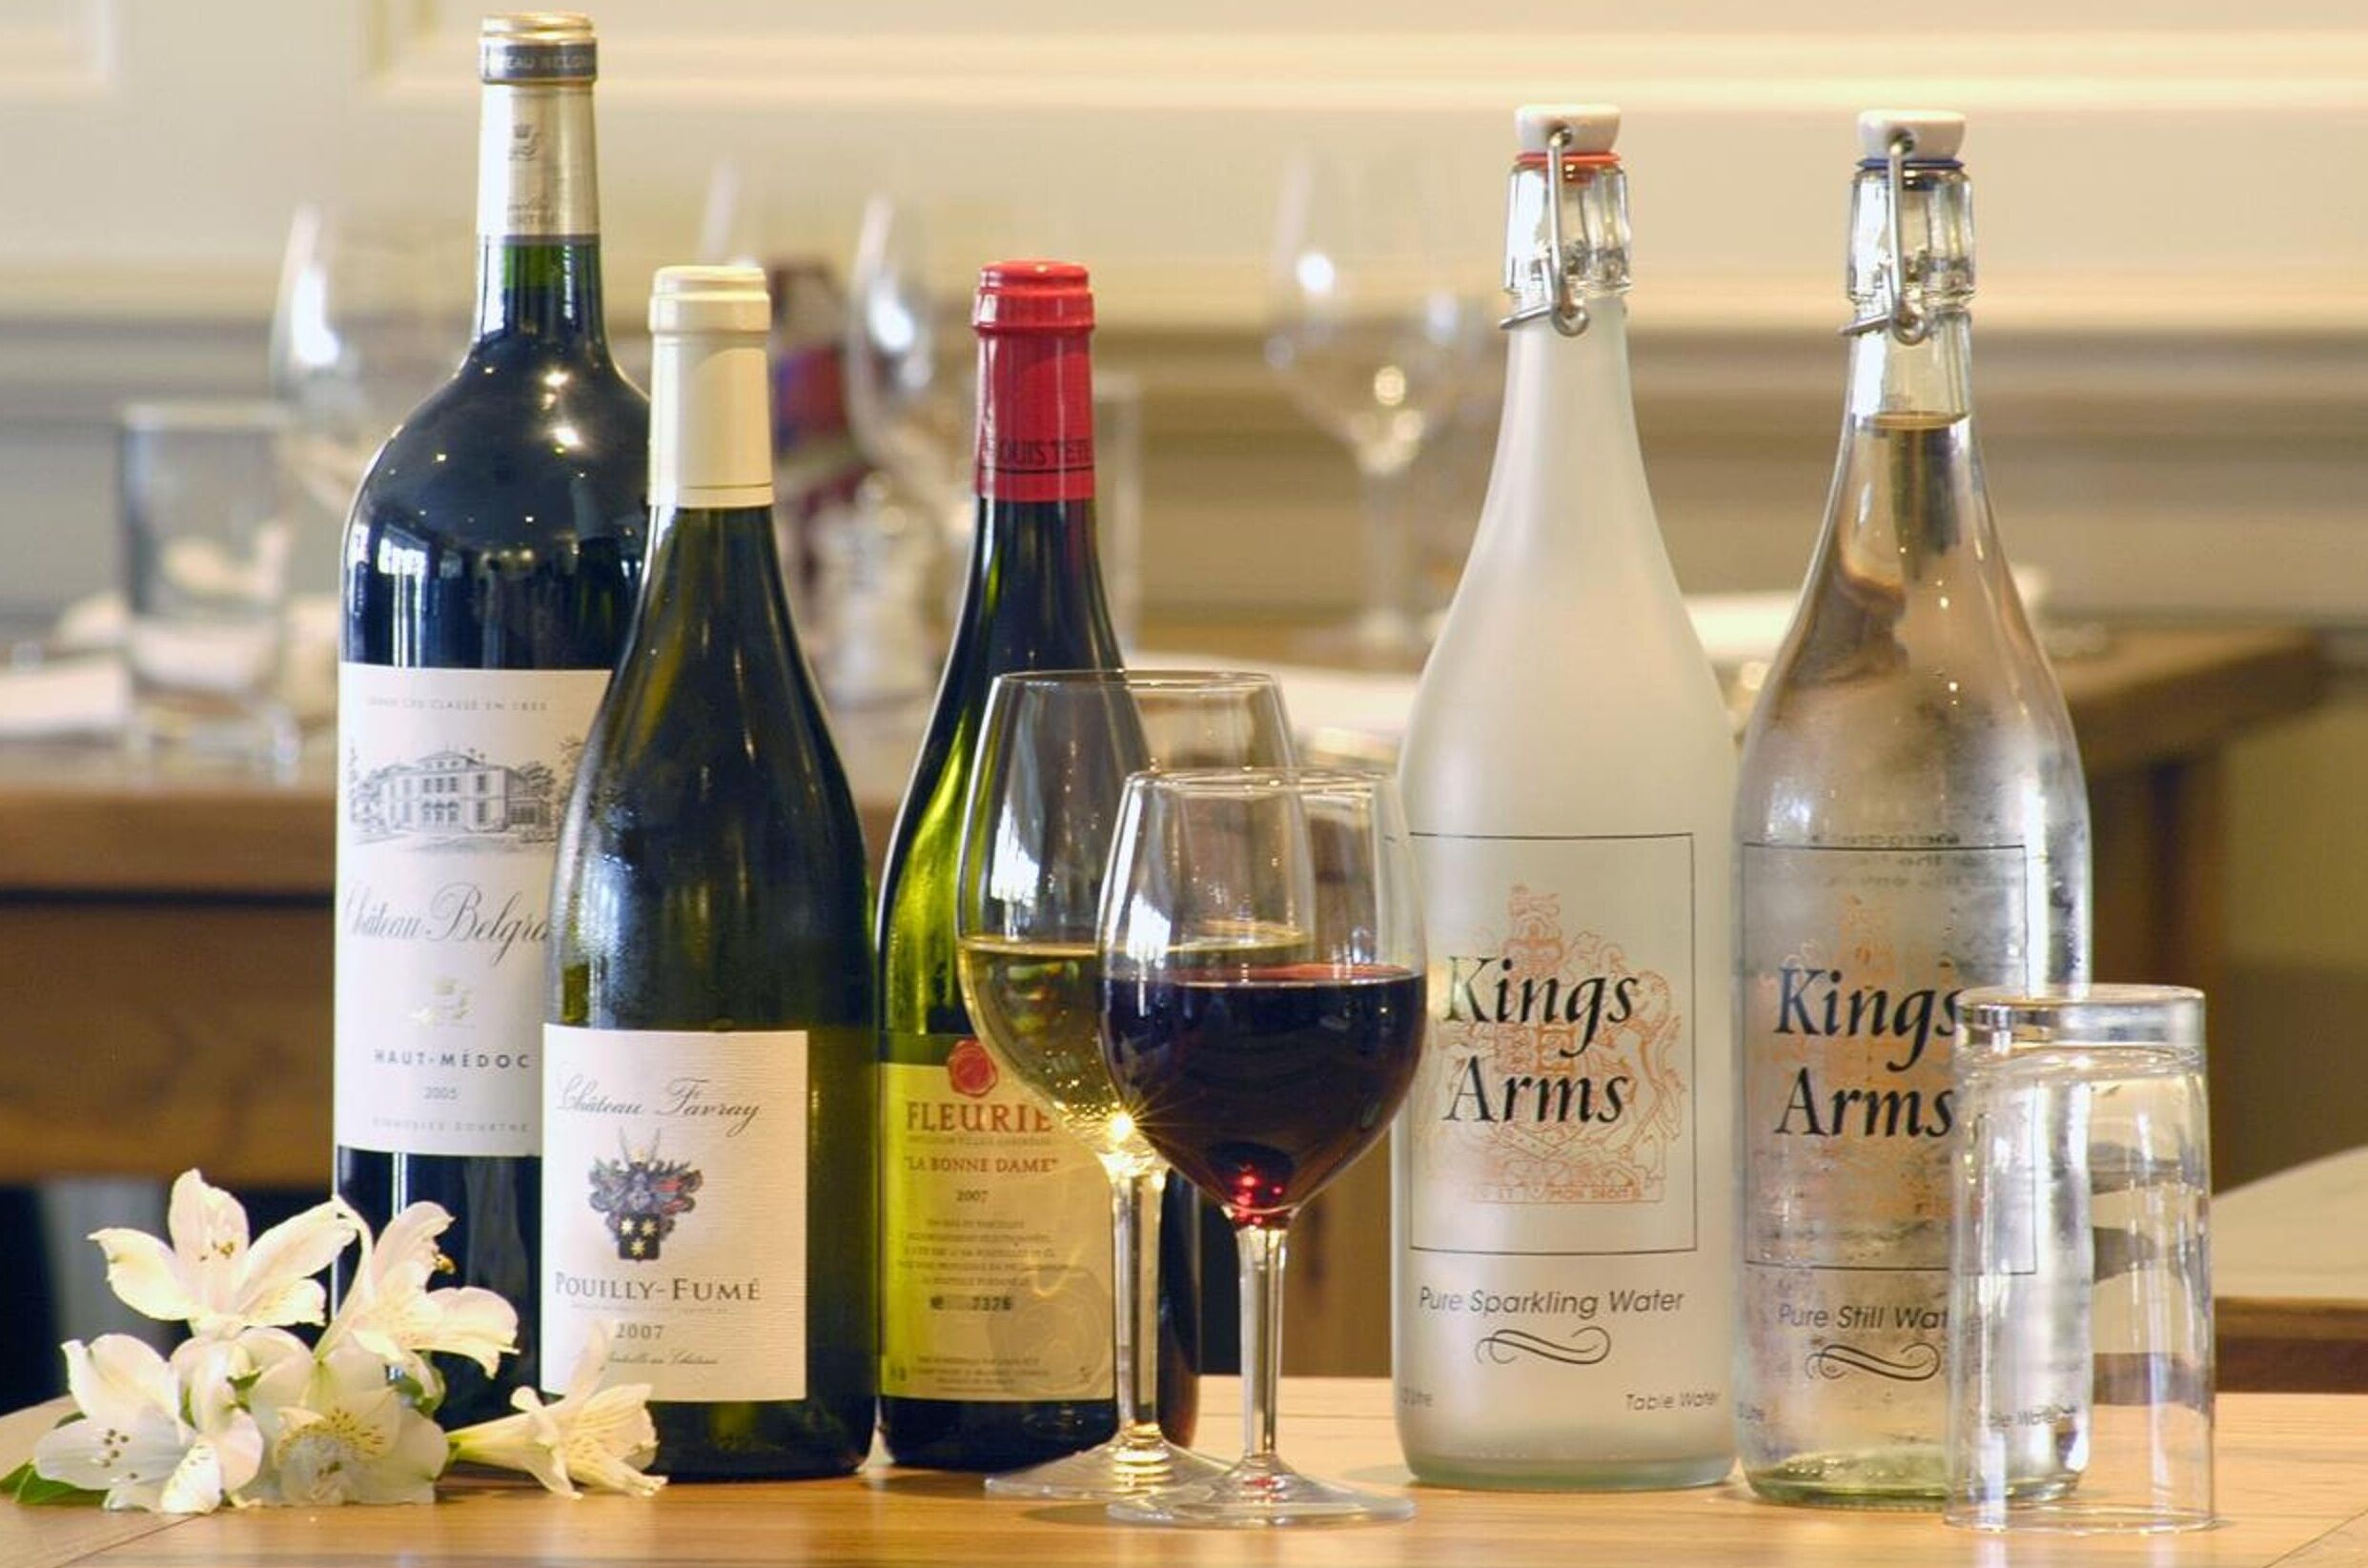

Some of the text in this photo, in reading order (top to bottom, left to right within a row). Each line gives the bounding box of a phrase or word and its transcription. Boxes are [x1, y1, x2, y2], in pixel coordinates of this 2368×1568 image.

[1443, 956, 1638, 1057] Kings
[556, 1061, 760, 1137] Château Favray
[1442, 1055, 1628, 1123] Arms
[1774, 1067, 1953, 1137] Arms
[931, 1157, 988, 1172] BONNE
[554, 1271, 762, 1302] POUILLY-FUMÉ
[1419, 1287, 1685, 1319] Pure Sparkling Water
[1778, 1302, 1949, 1330] Pure Still Wat
[616, 1322, 663, 1339] 2007
